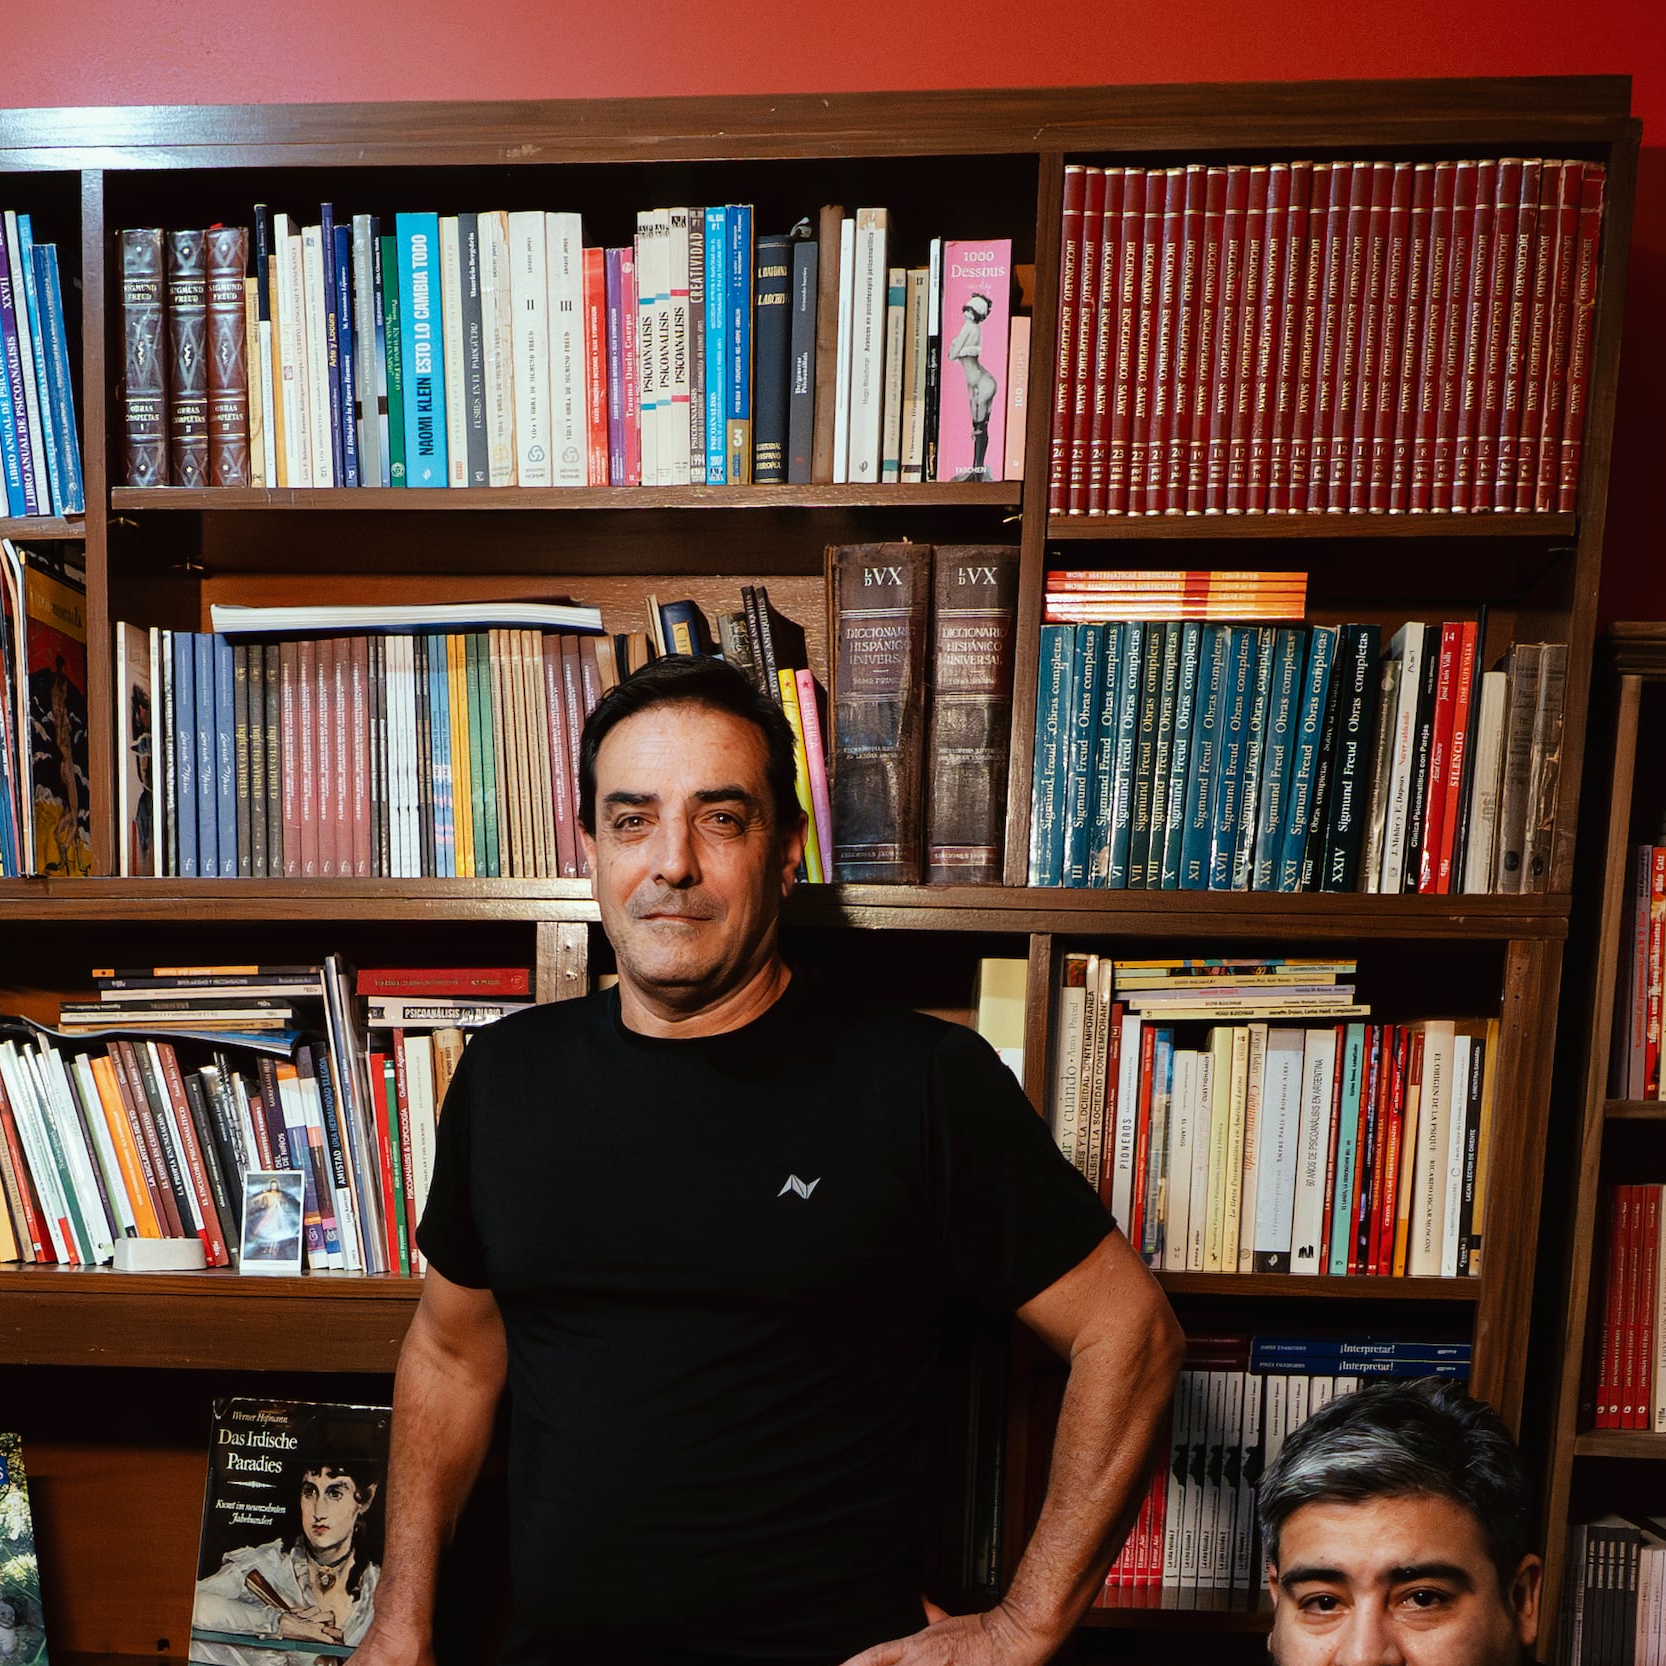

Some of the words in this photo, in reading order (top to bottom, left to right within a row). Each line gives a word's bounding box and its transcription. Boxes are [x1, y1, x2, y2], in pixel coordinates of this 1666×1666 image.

[411, 234, 428, 269] TODO
[689, 232, 704, 303] CREATIVIDAD
[963, 251, 995, 263] 1000
[951, 264, 1006, 278] Dessous
[1064, 240, 1076, 301] DICCIONARIO
[1124, 242, 1136, 303] DICCIONARIO
[1143, 243, 1155, 304] DICCIONARIO
[0, 277, 13, 309] XXVII
[412, 271, 430, 320] CAMBIA
[527, 299, 534, 311] II
[560, 300, 572, 311] III
[328, 312, 339, 344] Locura
[414, 322, 430, 340] LO
[329, 353, 337, 368] Arte
[415, 342, 432, 374] ESTO
[642, 316, 654, 393] PSICOANALISIS
[659, 312, 670, 388] PSICOANALISIS
[674, 307, 685, 384] PSICOANALISIS
[6, 336, 25, 416] PSICOANÁLISIS
[417, 377, 432, 413] KLEIN
[1057, 383, 1068, 413] SALVAT
[1117, 384, 1127, 416] SALVAT
[1135, 387, 1147, 418] SALVAT
[16, 417, 27, 433] DE
[418, 416, 434, 456] NAOMI
[19, 434, 31, 468] ANUAL
[1052, 448, 1065, 458] 26
[1112, 448, 1124, 459] 23
[1131, 449, 1144, 460] 22
[23, 469, 36, 507] LIBRO
[947, 640, 1002, 652] HISPÁNICO
[1083, 630, 1096, 690] completas
[1128, 629, 1141, 689] completas
[1211, 632, 1224, 690] completas
[1312, 632, 1327, 693] completas
[1355, 632, 1369, 692] completas
[1079, 692, 1091, 728] Obras
[1123, 694, 1135, 729] Obras
[1204, 694, 1217, 729] Obras
[1304, 696, 1319, 732] Obras
[1348, 697, 1361, 732] Obras
[1076, 739, 1088, 772] Freud
[1120, 738, 1132, 772] Freud
[1199, 741, 1212, 773] Freud
[1298, 745, 1313, 778] Freud
[1343, 741, 1357, 776] Freud
[1451, 731, 1464, 787] SILENCIO
[1073, 776, 1087, 828] Sigmund
[1117, 777, 1130, 829] Sigmund
[1194, 778, 1209, 829] Sigmund
[1291, 783, 1308, 835] Sigmund
[1338, 781, 1352, 832] Sigmund
[1072, 864, 1083, 879] III
[1112, 865, 1123, 879] VI
[1188, 860, 1200, 881] XII
[1284, 860, 1297, 886] XXI
[1331, 848, 1347, 883] XXIV
[404, 1007, 460, 1019] PSICOANÁLISIS
[398, 1071, 406, 1098] Guillermo
[1313, 1059, 1324, 1091] ARGENTINA
[1092, 1078, 1106, 1126] SOCIEDAD
[1312, 1092, 1321, 1101] EN
[399, 1108, 410, 1145] TOPOLOGÍA
[1091, 1130, 1100, 1141] LA
[1308, 1102, 1321, 1147] PSICOANÁLISIS
[1119, 1119, 1132, 1170] PIONEROS
[1308, 1149, 1318, 1158] DE
[333, 1149, 346, 1185] AMISTAD
[404, 1153, 414, 1200] PSICOANÁLISIS
[1306, 1159, 1317, 1177] AÑOS
[1306, 1177, 1316, 1188] 60
[1340, 1344, 1395, 1354] ¡Interpretar!
[1339, 1361, 1394, 1372] ¡Interpretar!
[233, 1411, 256, 1421] Werner
[218, 1429, 245, 1446] Das
[246, 1431, 298, 1450] Irdische
[226, 1452, 282, 1473] Paradies
[216, 1499, 235, 1510] Kunst
[236, 1502, 245, 1510] im
[229, 1512, 273, 1525] Jahrhundert
